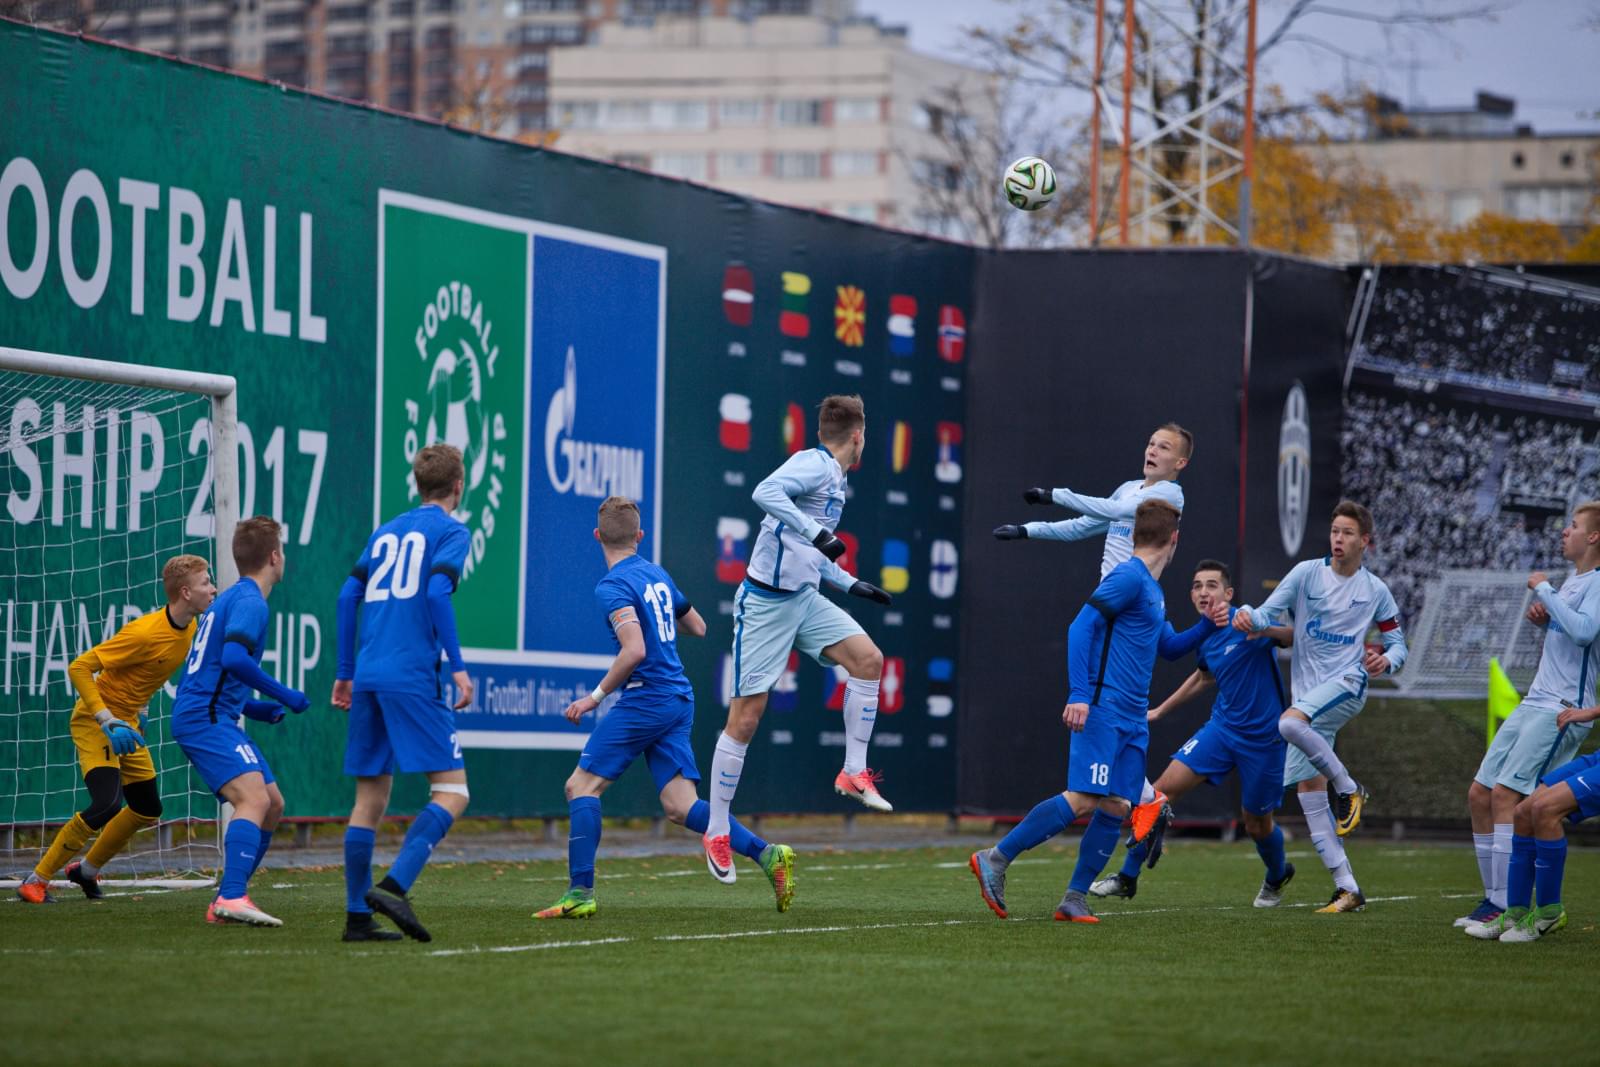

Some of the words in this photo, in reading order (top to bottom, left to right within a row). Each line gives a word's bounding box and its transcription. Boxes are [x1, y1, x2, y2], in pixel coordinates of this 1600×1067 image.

[0, 156, 327, 343] OOTBALL
[415, 280, 499, 378] FOOTBALL
[6, 397, 165, 532] SHIP
[365, 531, 426, 602] 20
[643, 582, 676, 642] 13
[485, 676, 535, 714] Football
[102, 745, 110, 761] 1
[1089, 762, 1109, 786] 18
